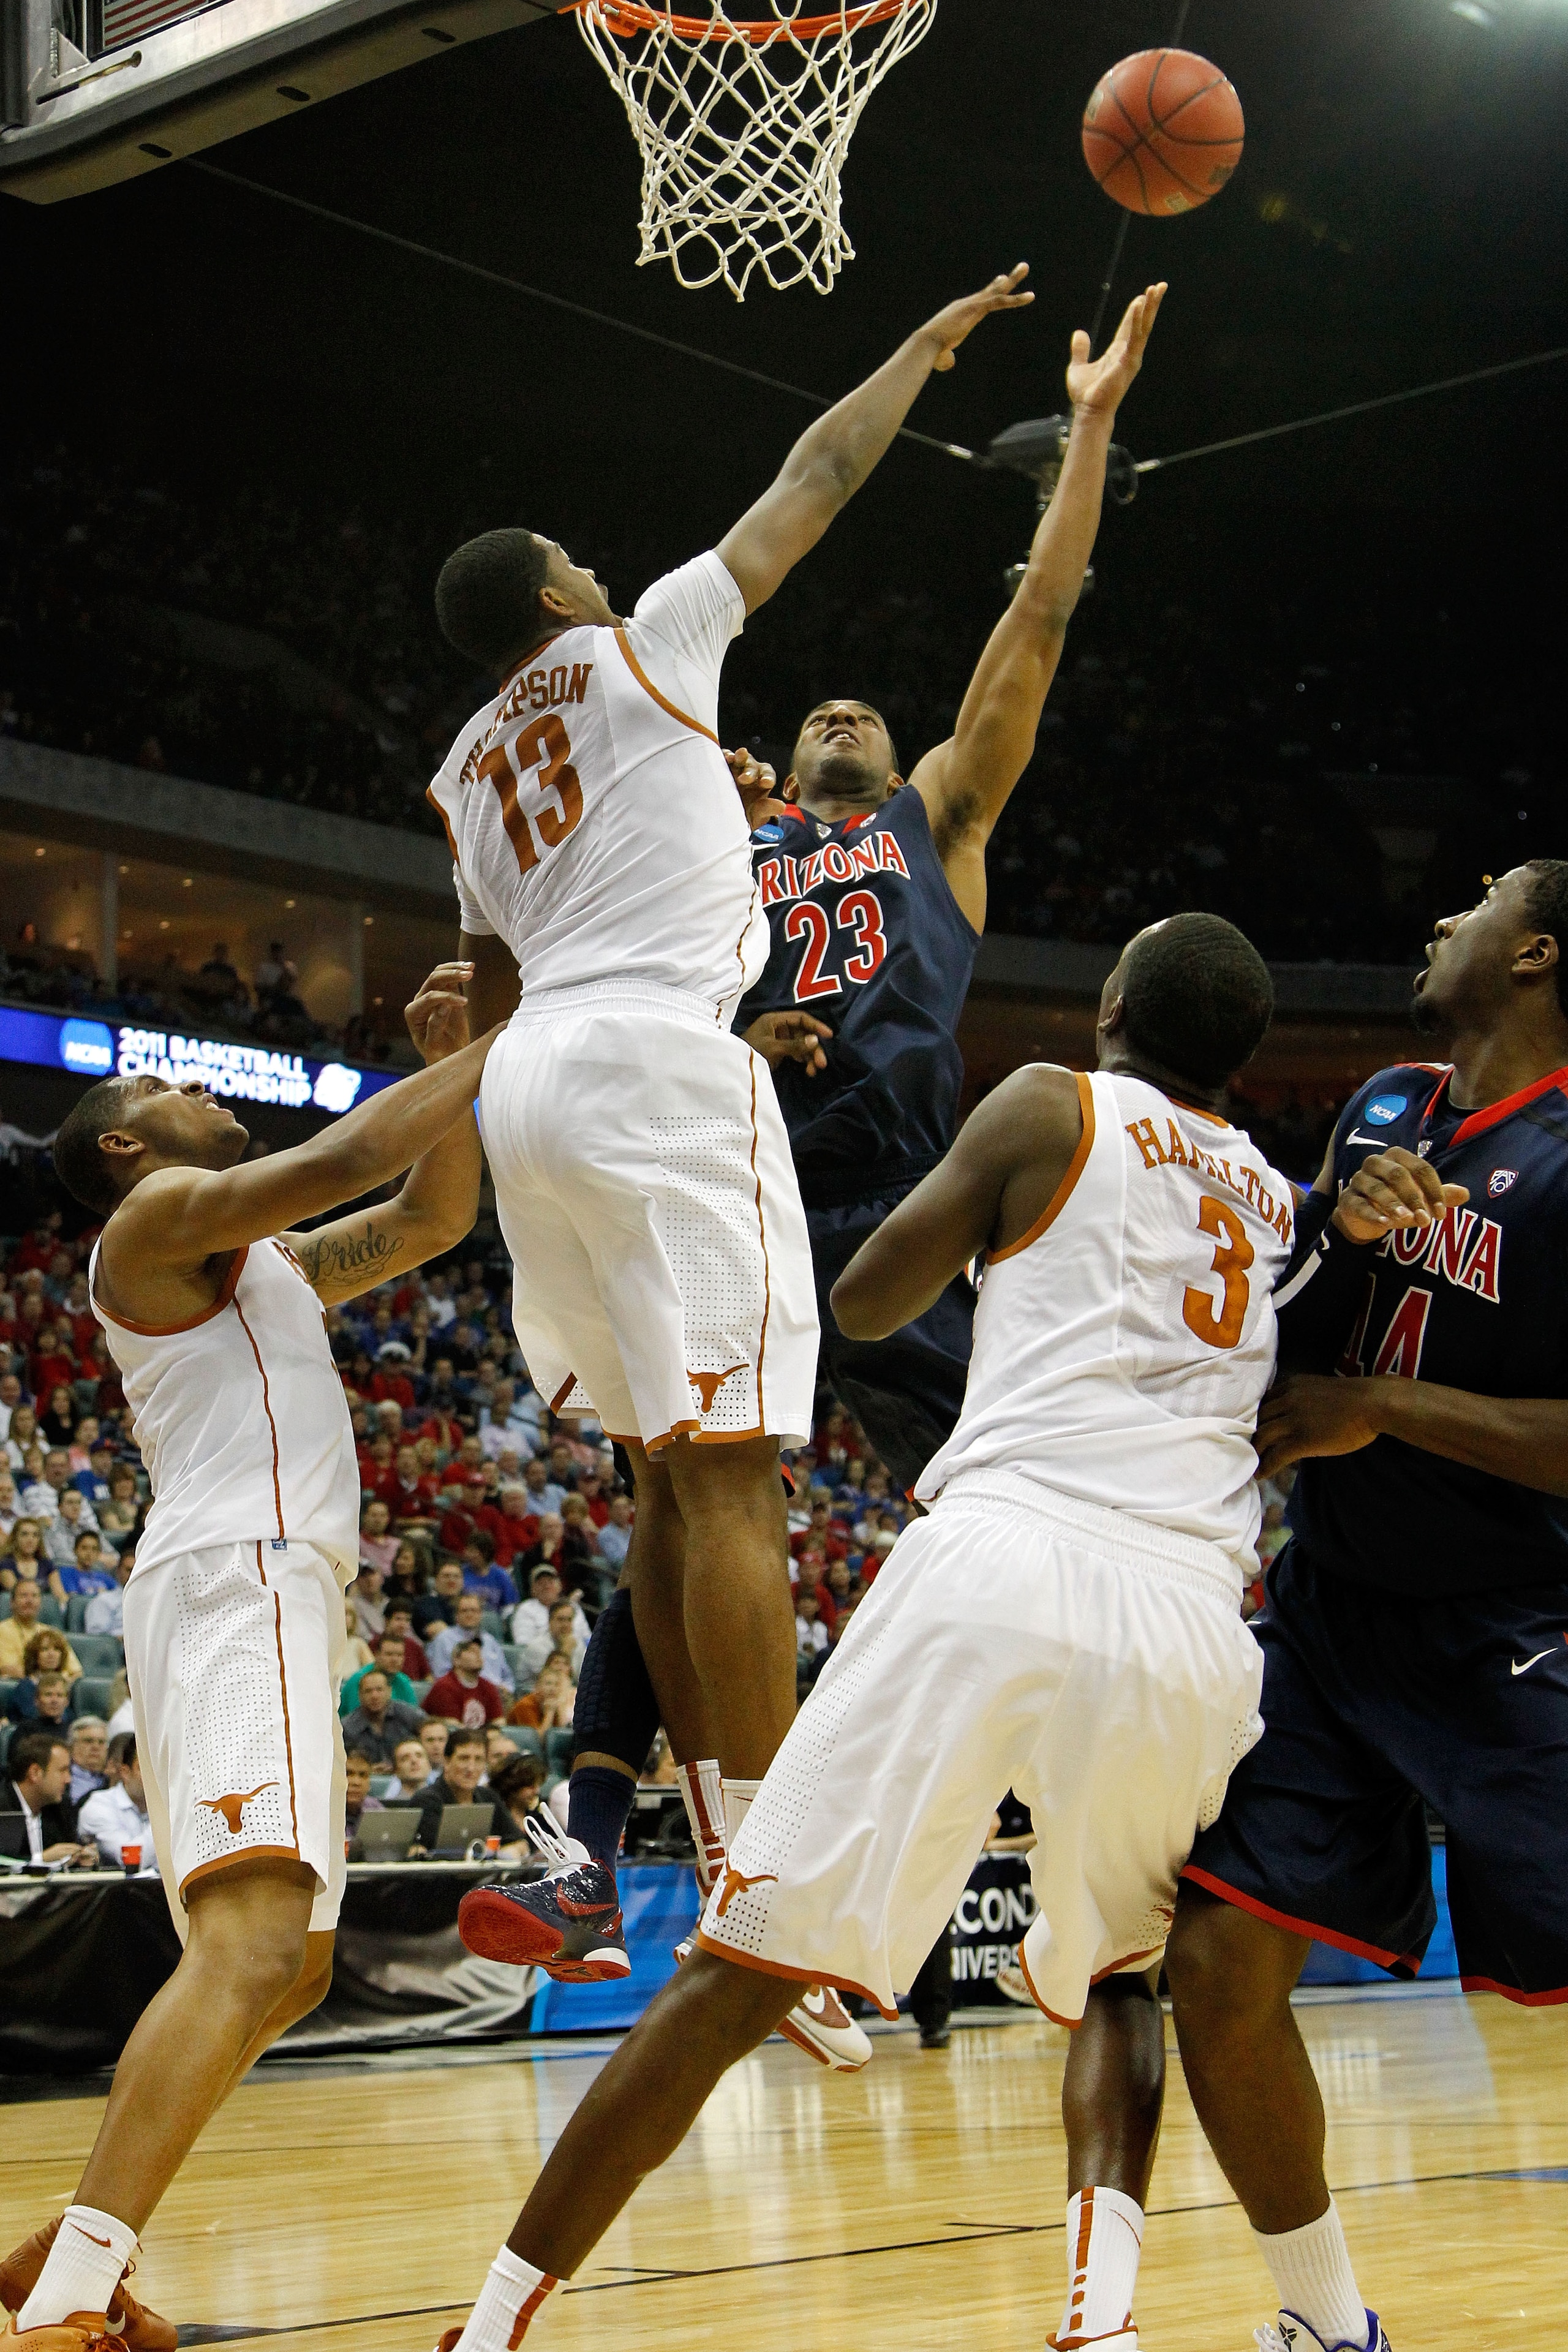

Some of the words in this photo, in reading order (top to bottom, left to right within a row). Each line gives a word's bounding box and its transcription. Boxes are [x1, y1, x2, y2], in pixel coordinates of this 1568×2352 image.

[477, 714, 583, 875] 13
[753, 829, 780, 840] NCAA
[785, 889, 888, 1003] 23
[117, 1052, 313, 1108] CHAMPIONSHIP
[118, 1026, 167, 1059] 2011
[169, 1035, 310, 1080] BASKETBALL
[1369, 1104, 1397, 1121] NCAA
[1490, 1169, 1517, 1188] PAC
[302, 1221, 388, 1281] Pride
[1182, 1195, 1254, 1349] 3
